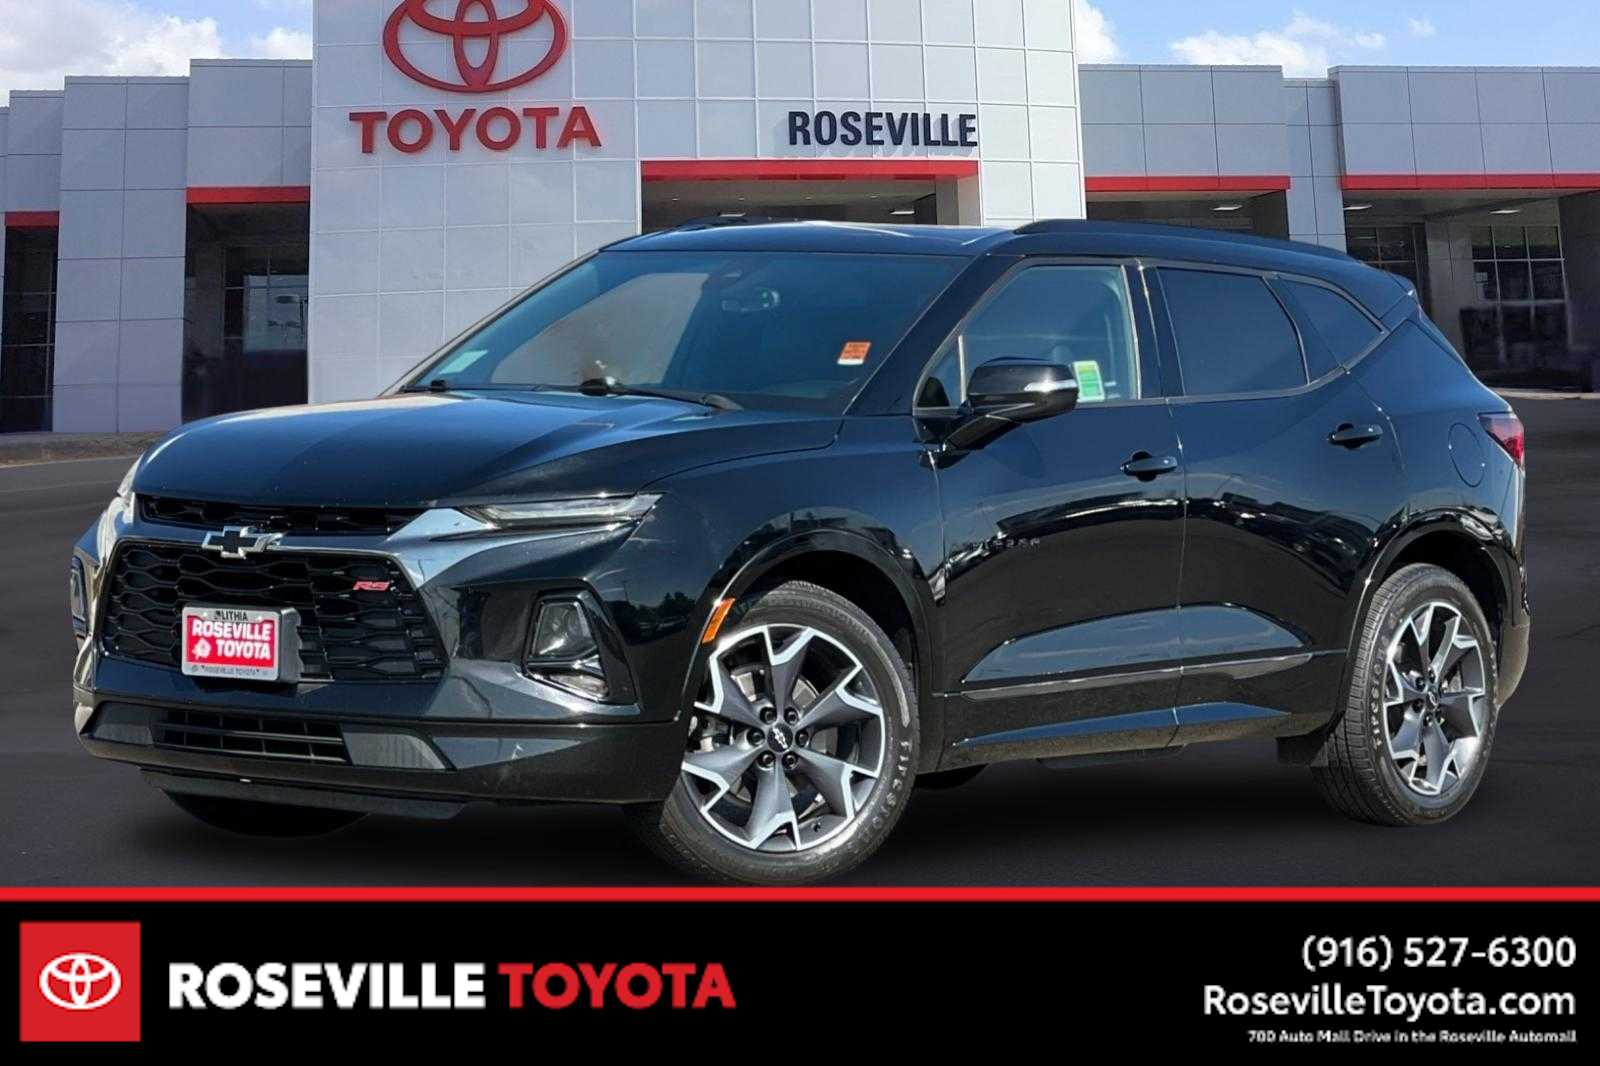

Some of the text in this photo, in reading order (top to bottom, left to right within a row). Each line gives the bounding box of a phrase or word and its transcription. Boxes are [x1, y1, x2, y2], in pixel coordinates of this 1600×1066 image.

[349, 106, 602, 154] TOYOTA
[788, 110, 978, 147] ROSEVILLE
[353, 581, 390, 591] RS
[221, 610, 248, 621] LITHIA
[191, 619, 273, 641] ROSEVILLE
[215, 640, 272, 660] TOYOTA
